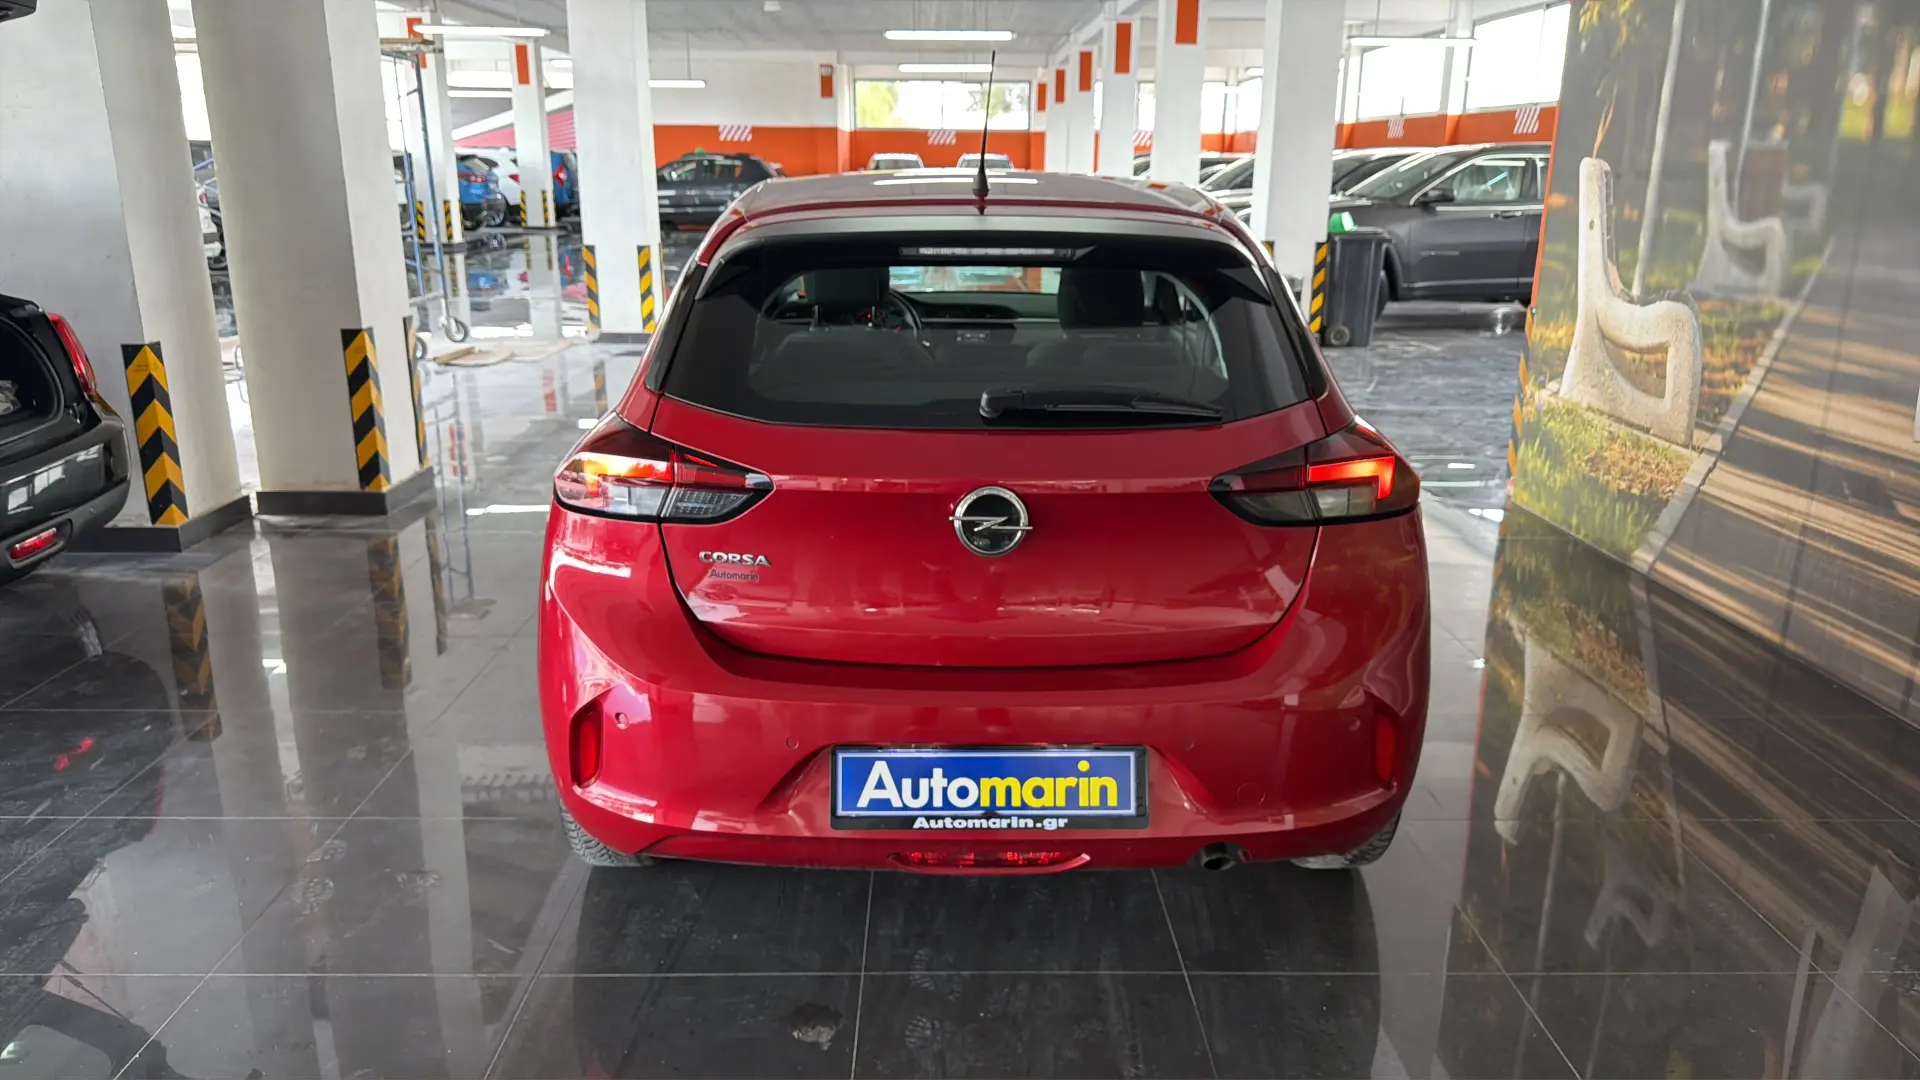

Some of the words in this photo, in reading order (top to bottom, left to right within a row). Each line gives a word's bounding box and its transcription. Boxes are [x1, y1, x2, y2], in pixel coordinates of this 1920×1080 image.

[698, 550, 771, 567] CORSA
[710, 569, 758, 581] Automarin
[856, 760, 1118, 808] Automarin
[912, 816, 1069, 830] Automarin.gr
